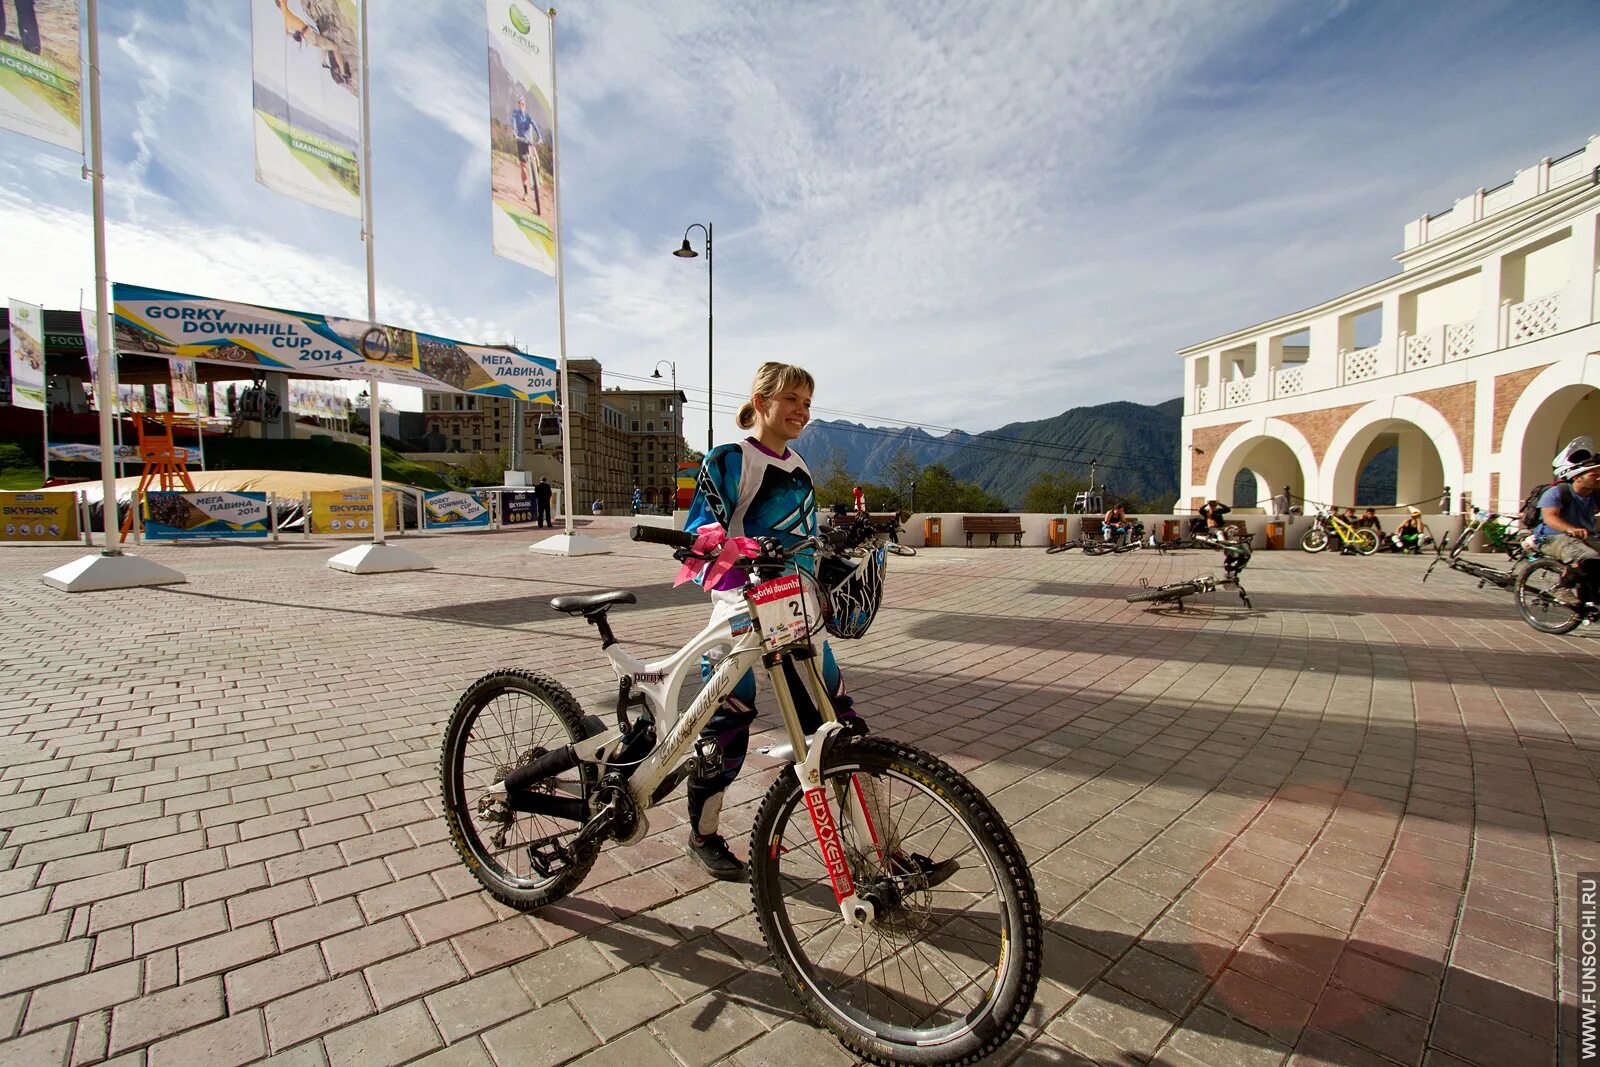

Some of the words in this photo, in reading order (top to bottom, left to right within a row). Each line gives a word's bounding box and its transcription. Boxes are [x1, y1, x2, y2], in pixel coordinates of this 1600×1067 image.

[145, 306, 225, 321] GORKY
[183, 321, 298, 336] DOWNHILL
[272, 337, 312, 348] CUP
[298, 350, 343, 361] 2014
[481, 355, 513, 365] МЕГА
[495, 366, 544, 377] ЛАВИНА
[527, 378, 552, 388] 2014
[196, 496, 224, 505] МЕГА
[209, 500, 252, 512] ЛАВИНА
[429, 497, 449, 506] GORKY
[438, 499, 468, 510] DOWNHILL
[3, 506, 58, 515] SKYPARK
[237, 507, 260, 516] 2014
[467, 506, 480, 514] 2014
[752, 586, 775, 601] gorki
[788, 600, 803, 617] 2
